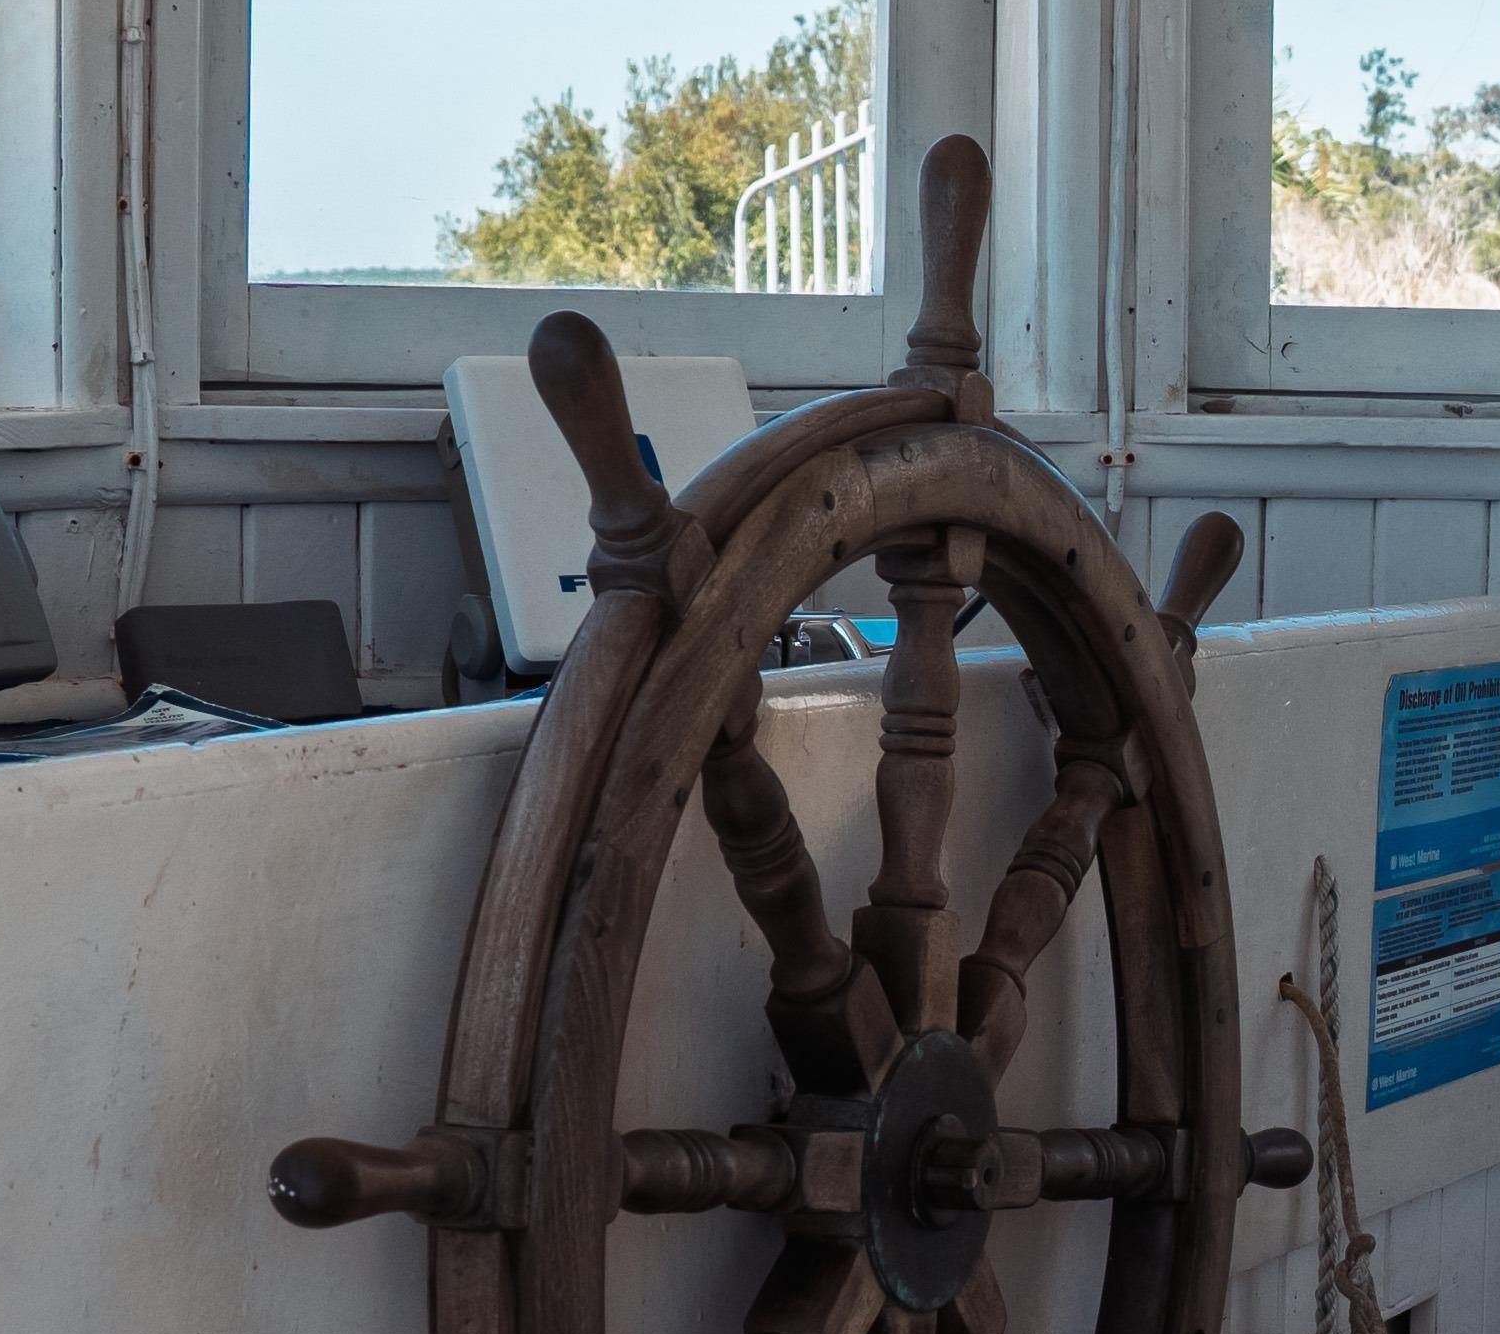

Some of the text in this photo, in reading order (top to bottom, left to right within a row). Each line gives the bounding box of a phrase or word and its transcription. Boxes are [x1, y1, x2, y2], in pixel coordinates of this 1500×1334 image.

[1398, 689, 1442, 711] Discharge
[1443, 687, 1453, 704] of
[1455, 681, 1466, 703] Oil
[1398, 848, 1440, 867] West Marine
[1379, 1066, 1418, 1089] West Marine
